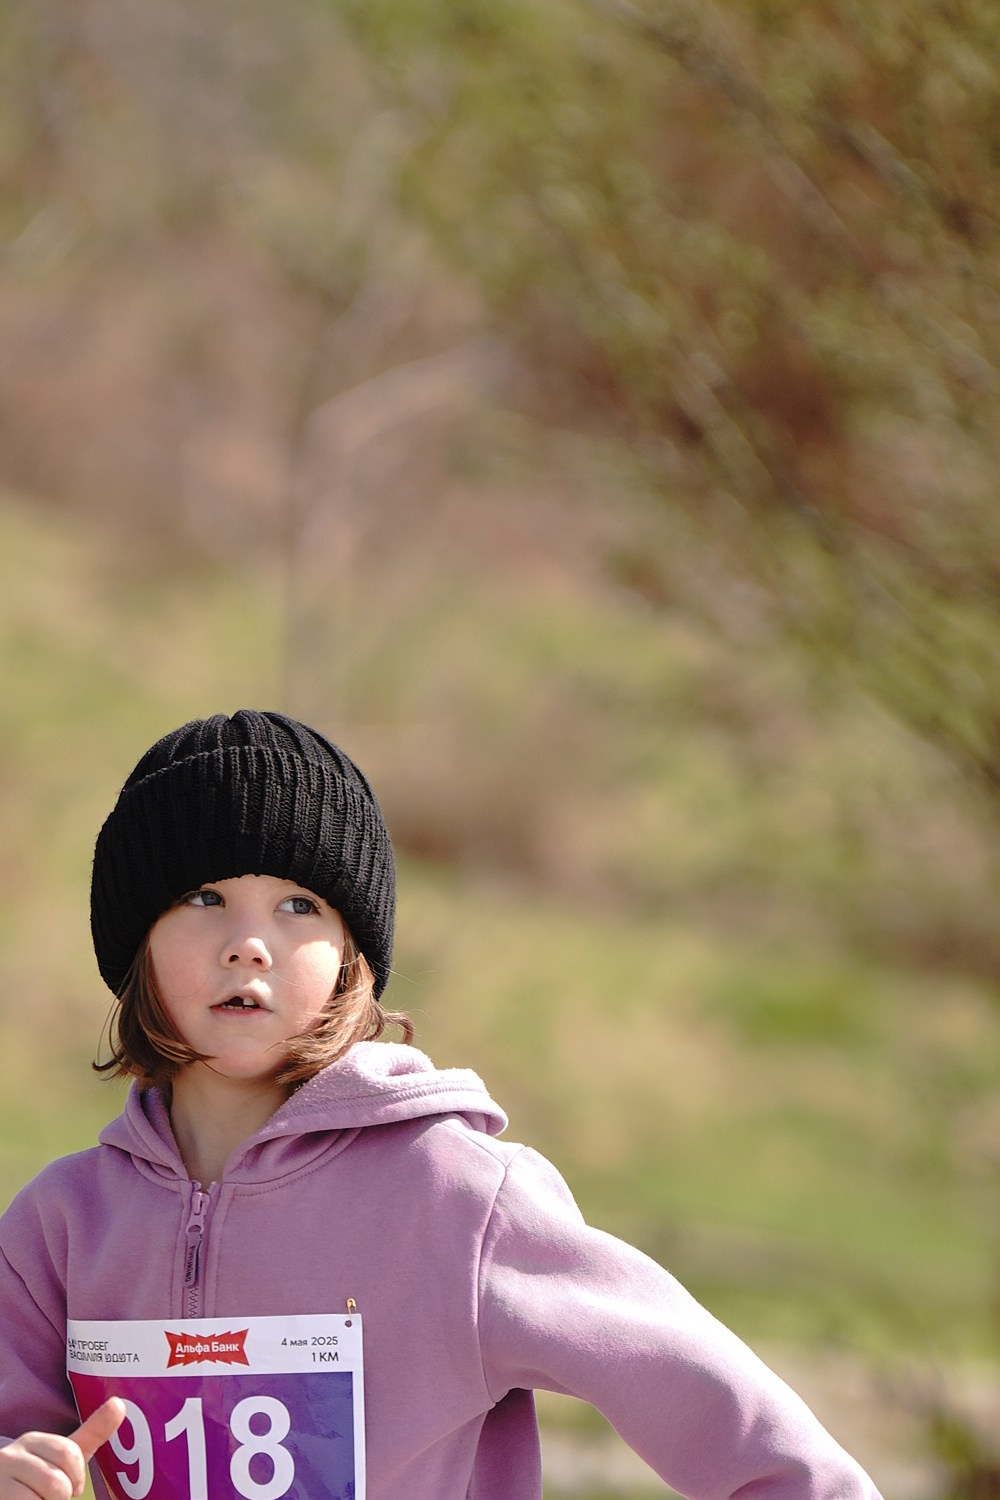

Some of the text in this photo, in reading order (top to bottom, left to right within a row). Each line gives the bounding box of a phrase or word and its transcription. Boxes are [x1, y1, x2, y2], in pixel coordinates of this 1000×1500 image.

[77, 1340, 109, 1351] ПРОБЕГ
[281, 1338, 287, 1346] 4
[311, 1336, 339, 1346] 2025
[175, 1341, 240, 1355] Альфа Банк
[312, 1351, 339, 1362] 1 КМ
